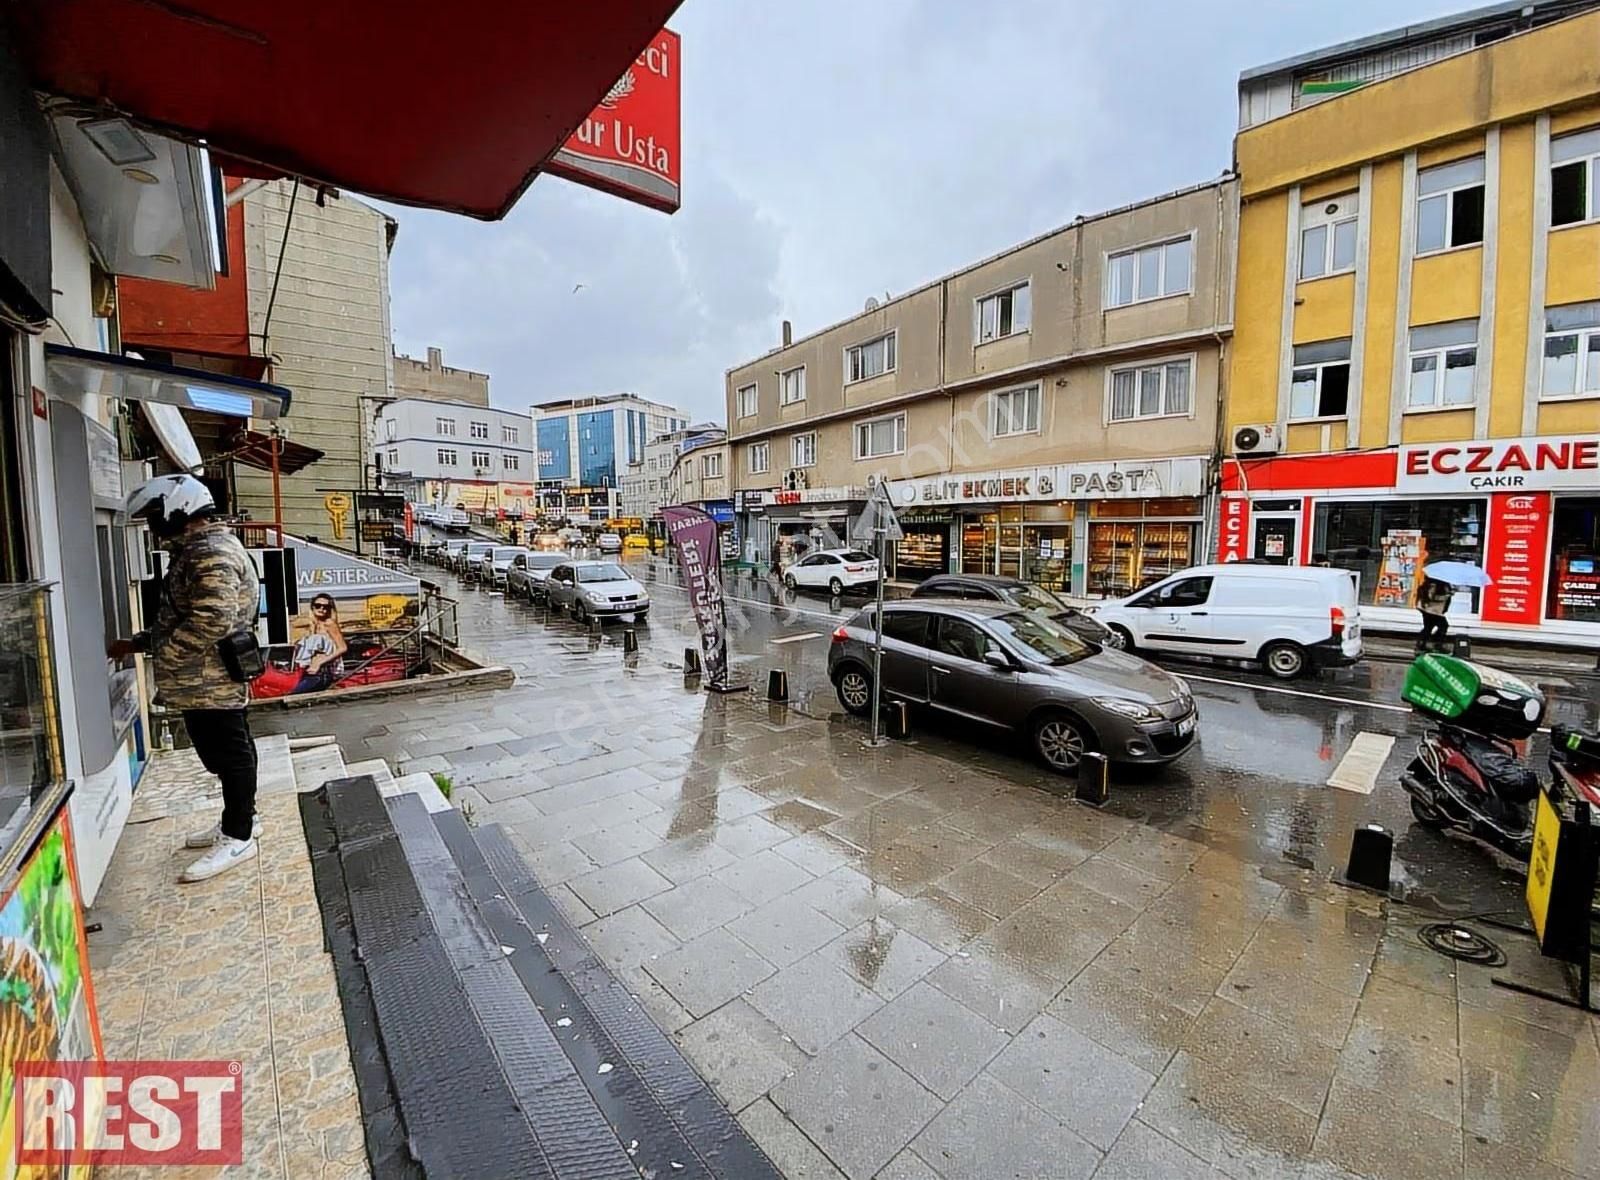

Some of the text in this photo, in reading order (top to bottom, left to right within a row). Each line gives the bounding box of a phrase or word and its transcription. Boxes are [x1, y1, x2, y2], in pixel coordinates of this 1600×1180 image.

[571, 118, 668, 174] ur Usta
[1406, 440, 1599, 476] ECZANE
[962, 477, 1030, 498] EKMEK
[1038, 476, 1053, 494] &
[1071, 468, 1162, 493] PASTA
[1470, 475, 1525, 490] ÇAKIR
[1562, 582, 1597, 590] ÇAKIR
